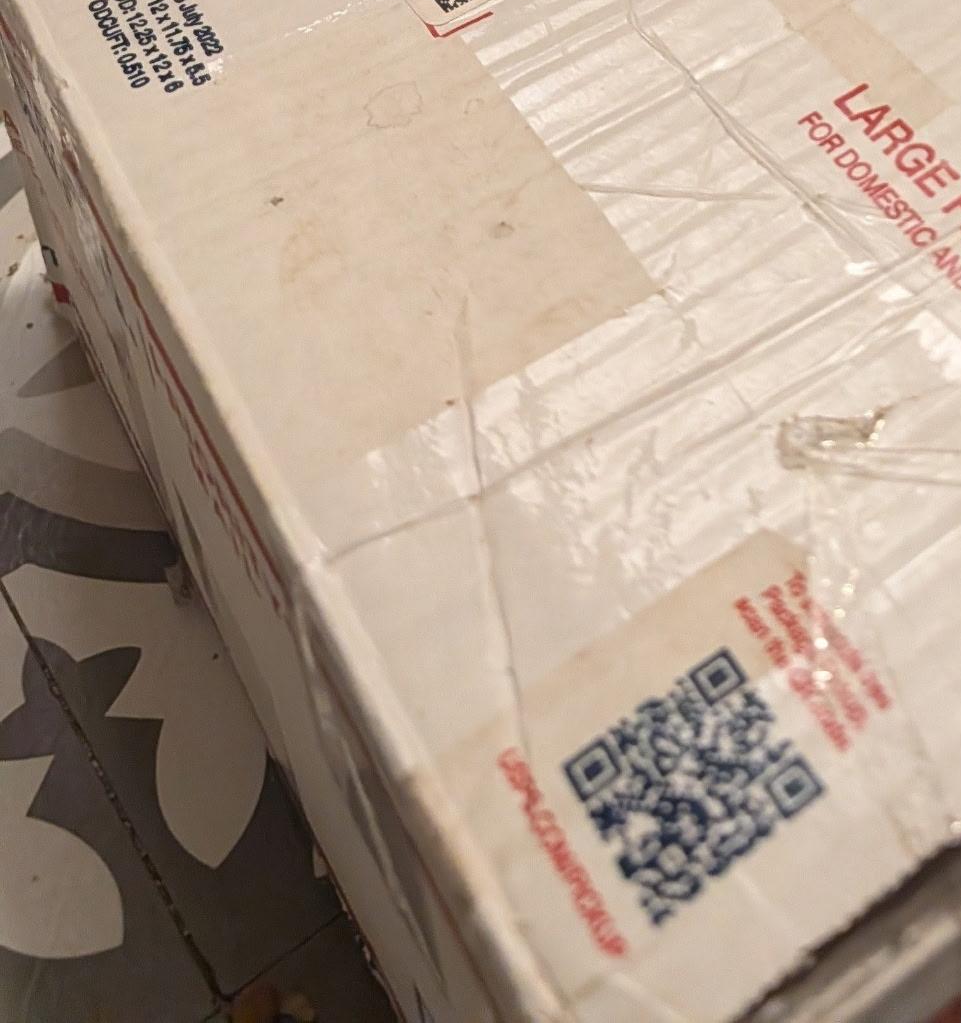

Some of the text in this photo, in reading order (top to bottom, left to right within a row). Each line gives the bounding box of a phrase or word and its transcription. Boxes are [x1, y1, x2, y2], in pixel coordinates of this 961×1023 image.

[126, 11, 157, 46] 12.25
[155, 13, 171, 25] x
[162, 21, 194, 56] 11.75
[179, 3, 203, 27] July
[193, 25, 224, 57] 2022
[143, 43, 159, 57] x
[149, 53, 172, 73] 12
[179, 54, 196, 67] x
[158, 70, 175, 83] x
[164, 79, 184, 94] 6
[833, 82, 961, 199] LARGE
[797, 110, 846, 155] FOR
[832, 147, 938, 248] DOMESTIC
